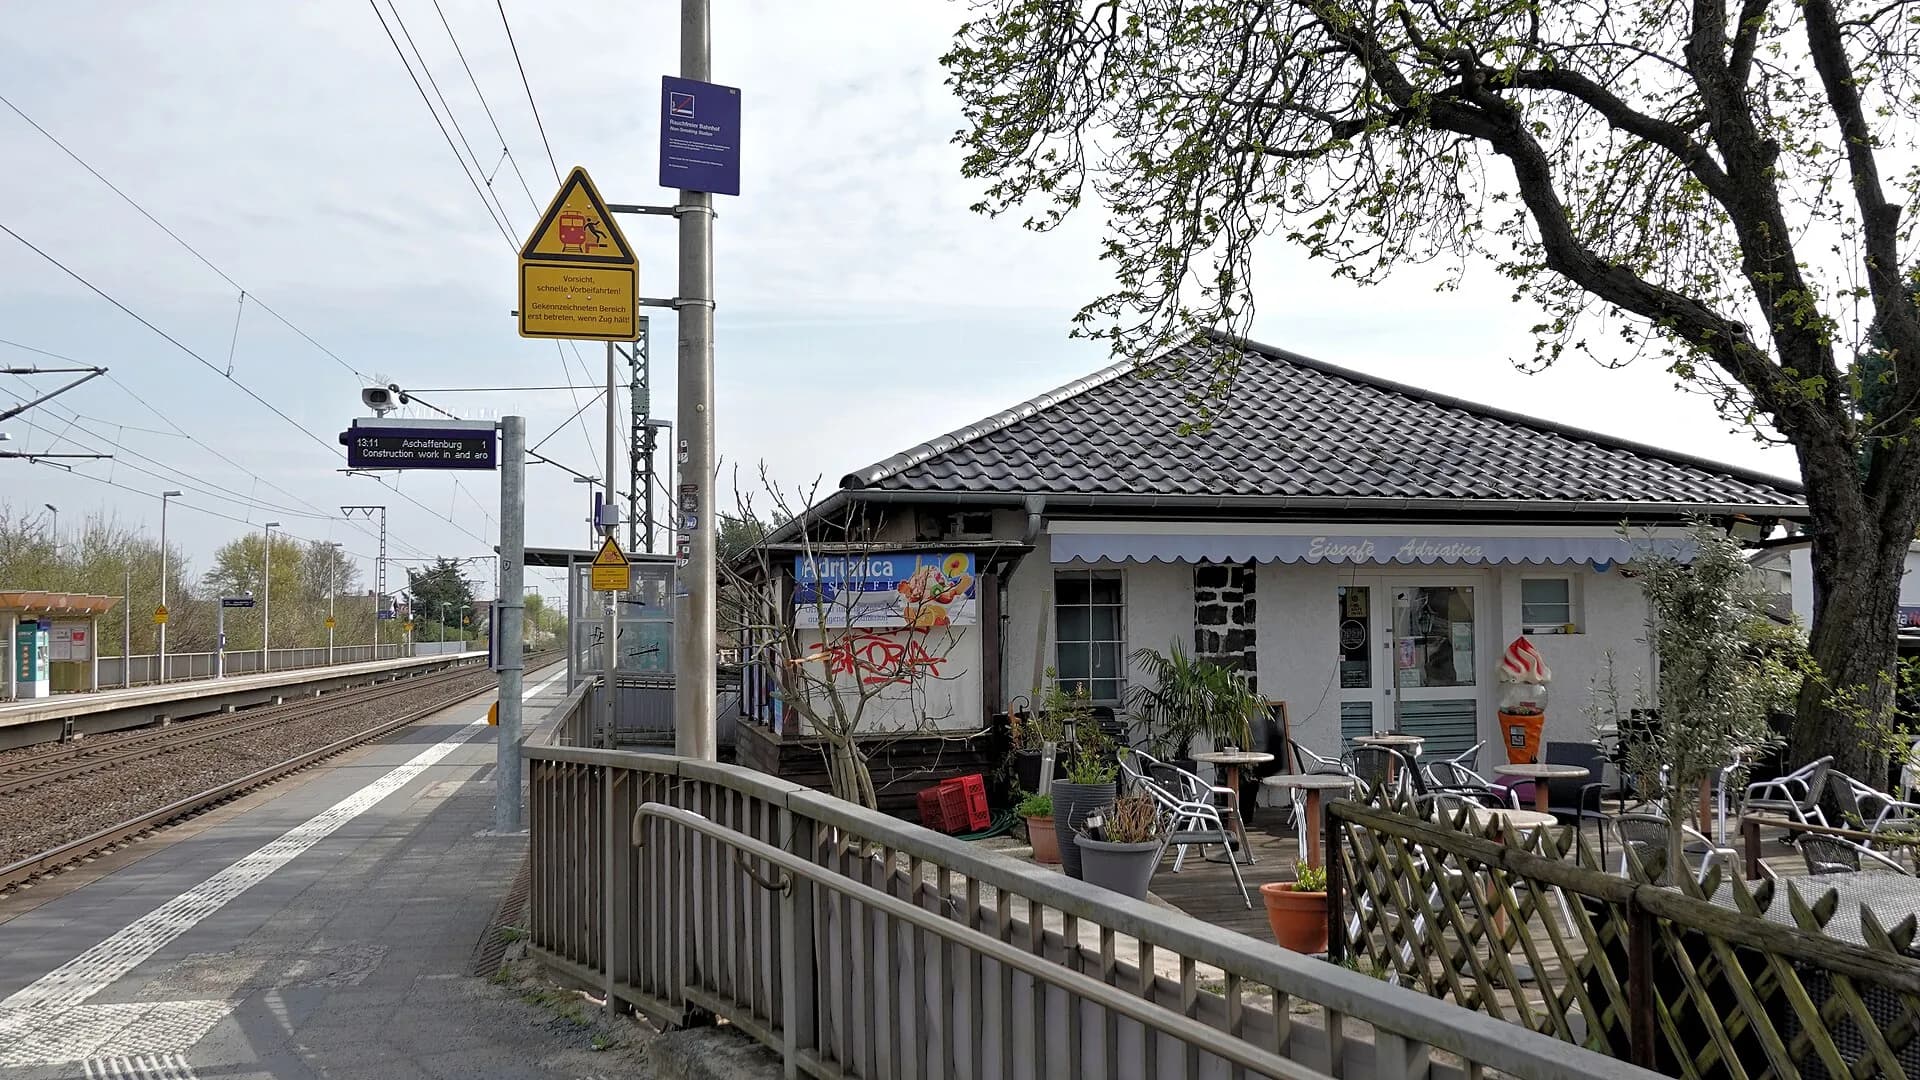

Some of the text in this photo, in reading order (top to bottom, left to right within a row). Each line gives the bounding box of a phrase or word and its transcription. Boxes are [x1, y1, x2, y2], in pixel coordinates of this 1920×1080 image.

[699, 123, 720, 132] Bahnhof
[563, 275, 595, 284] Vorsicht,
[570, 286, 621, 295] Vorbeifahrten!
[532, 302, 626, 313] Gekennzeichneten Bereich
[544, 313, 576, 322] betreten,
[598, 316, 612, 325] Zug
[613, 316, 630, 324] hält!
[356, 438, 487, 450] 13:11 Aschaffenburg 1
[362, 449, 414, 458] Construction
[418, 449, 439, 459] work
[443, 450, 451, 459] in
[455, 450, 470, 459] and
[1396, 538, 1483, 558] Adriatica
[801, 556, 893, 578] Adriatica
